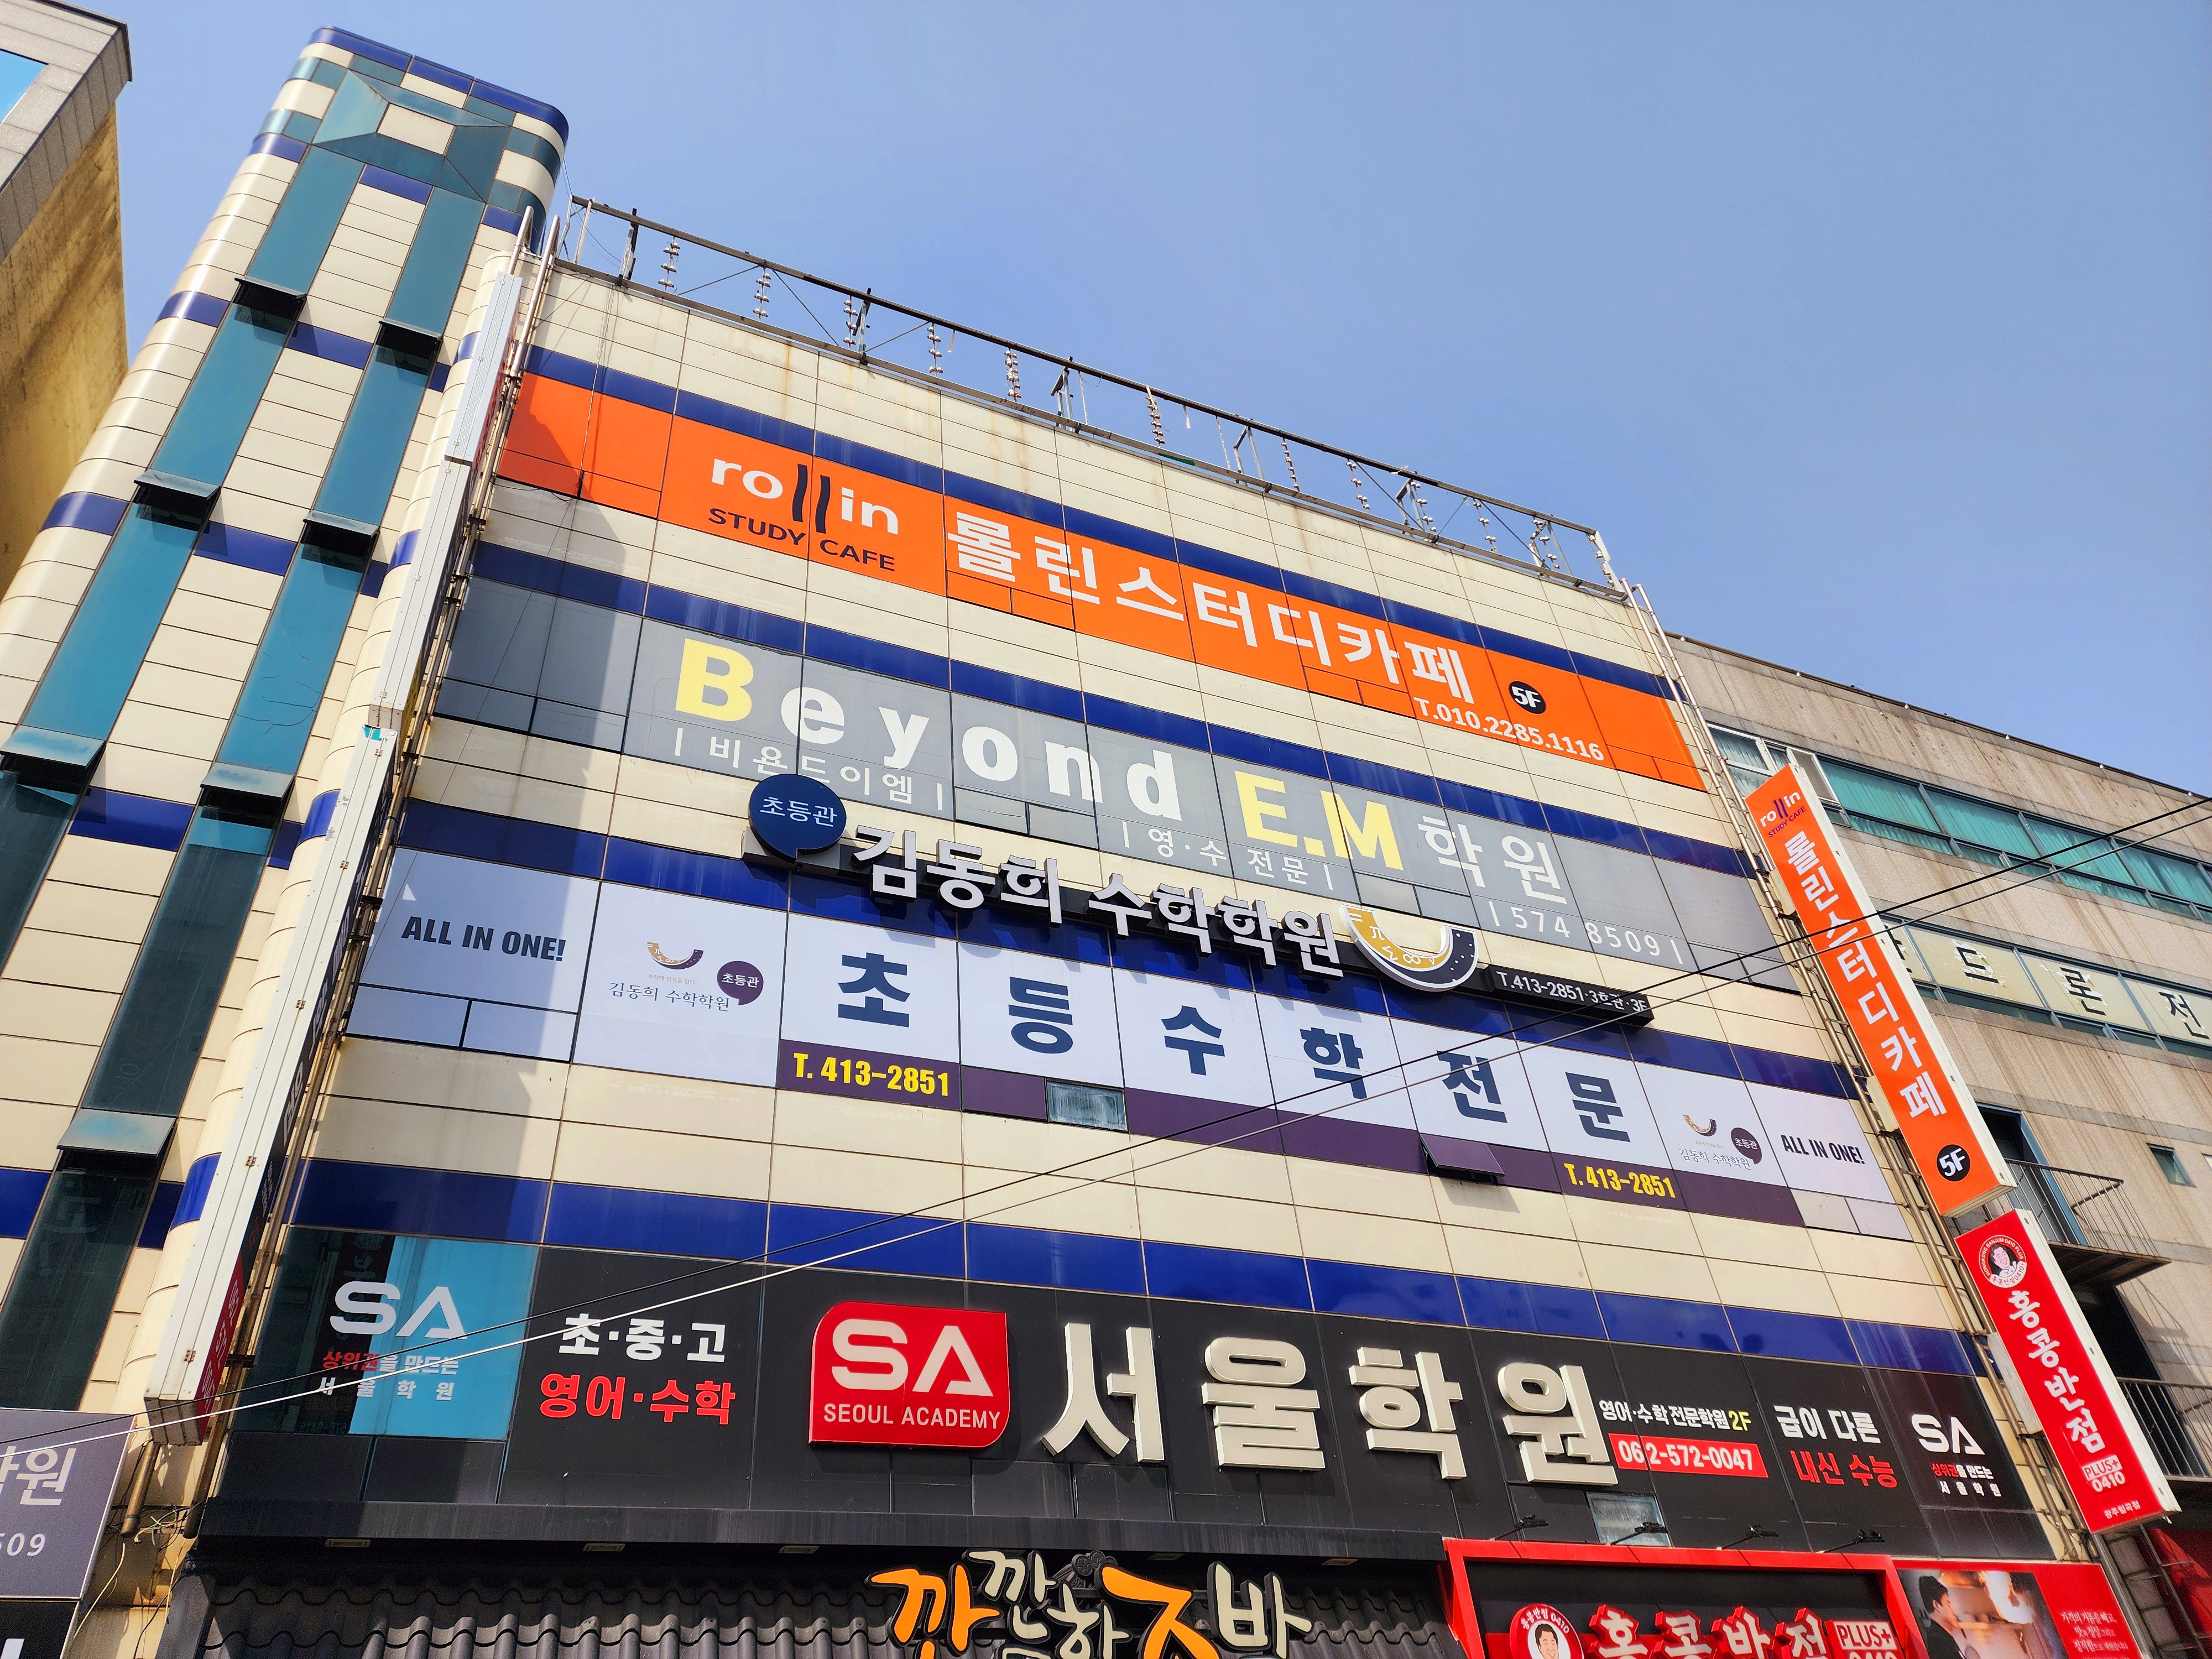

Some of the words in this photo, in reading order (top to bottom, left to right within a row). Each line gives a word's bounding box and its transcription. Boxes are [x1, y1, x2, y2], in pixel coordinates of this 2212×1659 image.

[712, 457, 899, 535] rollin
[708, 508, 806, 546] STUDY
[820, 539, 896, 572] CAFE
[947, 511, 1474, 705] 롤린스터디카페
[1511, 686, 1542, 709] 5F
[1413, 696, 1605, 761] T.010.2285.1116
[674, 638, 1182, 822] Beyond
[1417, 814, 1567, 904] 학원
[759, 794, 838, 829] 초등관
[1760, 792, 1801, 827] rollin
[1768, 820, 1788, 838] STUDY
[1789, 806, 1806, 822] CAFE
[1247, 846, 1309, 884] 전문
[852, 825, 1063, 927] 김동희
[1085, 872, 1344, 980] 수학학원
[401, 915, 452, 946] ALL
[462, 925, 494, 952] IN
[502, 931, 566, 963] ONE!
[1585, 921, 1660, 957] 8509
[721, 973, 760, 989] 초등관
[1784, 830, 1947, 1118] 롤린스터디카페
[608, 982, 658, 1001] 김동희
[665, 990, 729, 1012] 수학학원
[821, 1057, 949, 1097] 413-2851
[1679, 1148, 1709, 1164] 김동희
[1712, 1153, 1752, 1171] 수학학원
[1734, 1137, 1759, 1150] 초등관
[1780, 1134, 1809, 1155] ALL
[1808, 1140, 1829, 1159] IN
[1829, 1143, 1866, 1165] ONE!
[1940, 1147, 1968, 1177] 5F
[1586, 1165, 1676, 1199] 413-2851
[2015, 1246, 2024, 1260] PLUS
[330, 1281, 467, 1340] SA
[832, 1318, 994, 1397] SA
[2008, 1289, 2107, 1454] 홍콩반점
[823, 1403, 894, 1425] SEOUL
[901, 1405, 1000, 1430] ACADEMY
[1041, 1322, 1618, 1486] 서울학원
[1773, 1404, 1827, 1441] 급이
[1830, 1410, 1881, 1444] 다른
[1911, 1413, 1985, 1455] SA
[1618, 1439, 1752, 1470] 062-572-0047
[1790, 1449, 1846, 1486] 내신
[1848, 1453, 1898, 1489] 수능
[1966, 1465, 1994, 1480] 만드는
[2091, 1471, 2126, 1493] 0410
[1550, 1612, 1570, 1635] 0410
